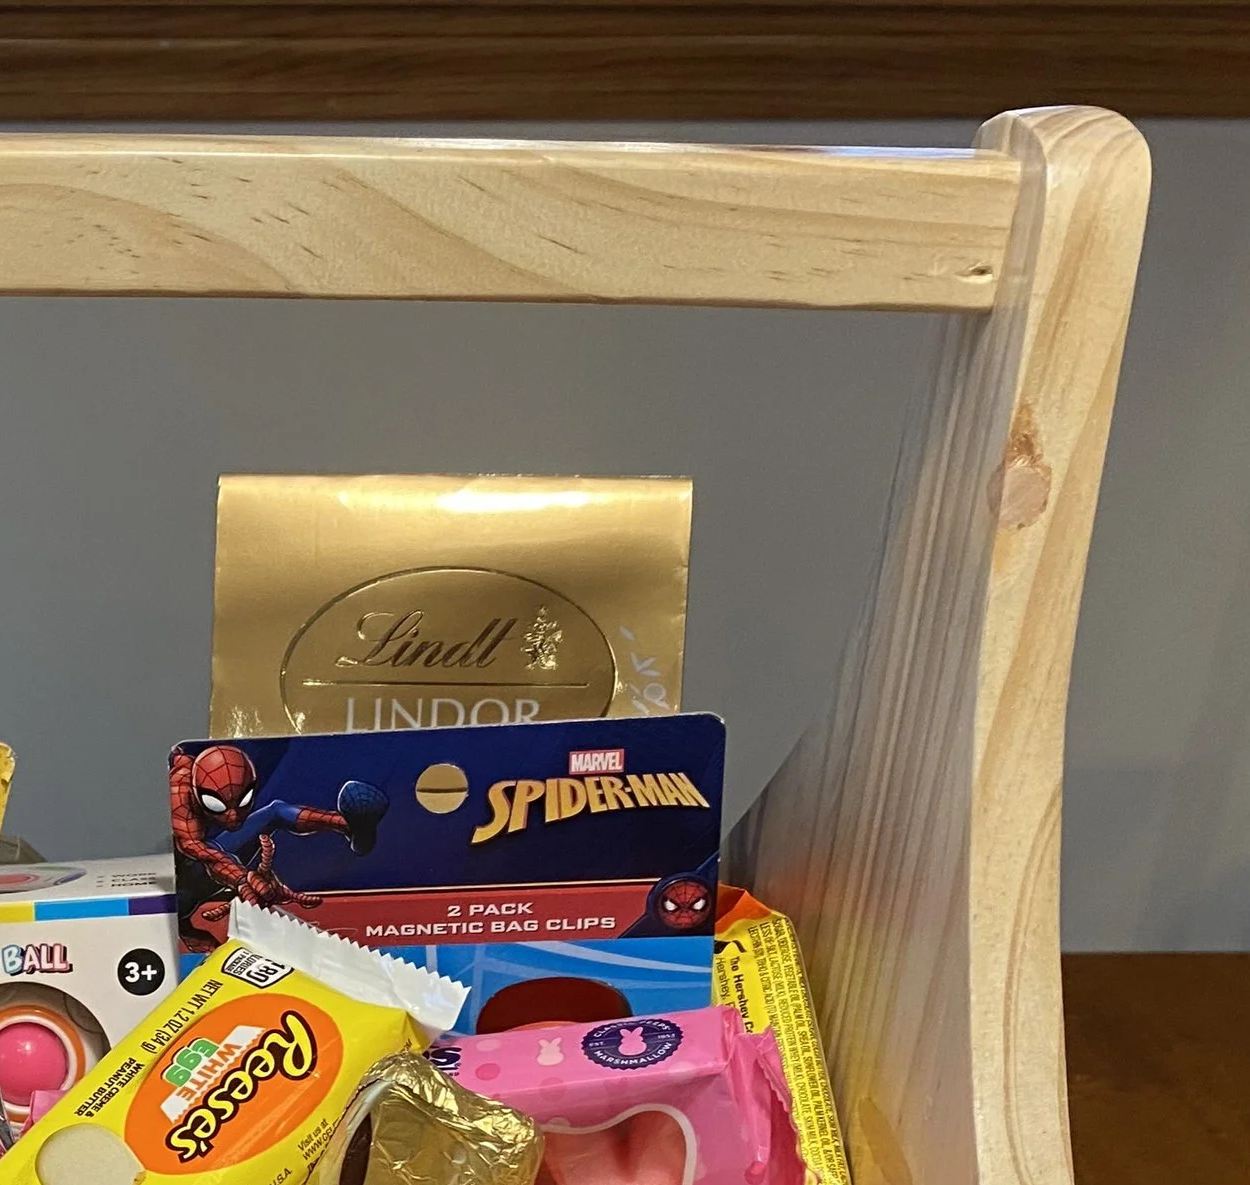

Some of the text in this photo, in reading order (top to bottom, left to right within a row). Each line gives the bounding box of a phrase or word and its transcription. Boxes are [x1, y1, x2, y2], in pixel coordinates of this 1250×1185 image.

[335, 609, 517, 670] Lindt
[346, 697, 540, 734] LINDOR
[571, 752, 623, 772] MARVEL
[470, 772, 711, 845] SPIDER-MAN
[365, 916, 616, 938] MAGNETIC BAG CLIPS
[447, 902, 534, 918] 2 PACK
[1, 943, 71, 975] BALL
[125, 961, 158, 983] 3+
[733, 974, 750, 1019] Hershey
[139, 976, 223, 1058] NET WT 1.2 OZ (34 g)
[161, 1037, 220, 1088] Egg
[593, 1041, 673, 1065] MARSHMALLOW
[73, 1056, 137, 1119] PEANUT BUTTER
[115, 1060, 145, 1089] WHITE
[167, 1011, 316, 1162] Reese's
[175, 1043, 242, 1101] WHITE
[90, 1084, 120, 1115] CREME
[298, 1133, 314, 1152] Visit
[312, 1126, 322, 1138] us
